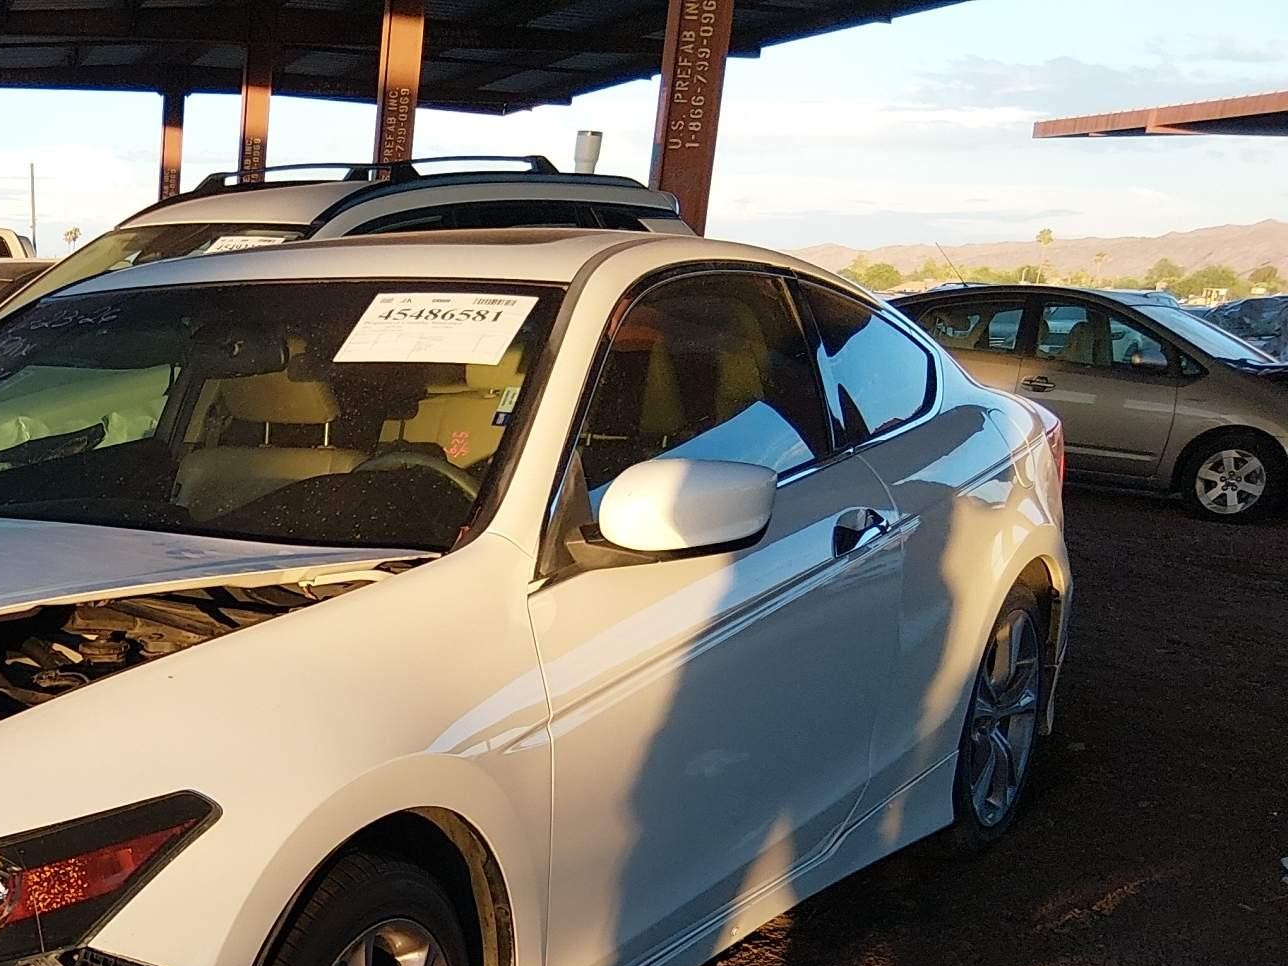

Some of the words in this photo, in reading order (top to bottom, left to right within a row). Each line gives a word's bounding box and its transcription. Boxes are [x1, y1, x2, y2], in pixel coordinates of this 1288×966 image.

[684, 0, 699, 20] IN
[673, 30, 696, 103] PREFAB
[388, 87, 399, 110] INC.
[394, 88, 410, 162] -799-0969
[668, 114, 686, 149] U.S.
[378, 308, 504, 322] 45486581
